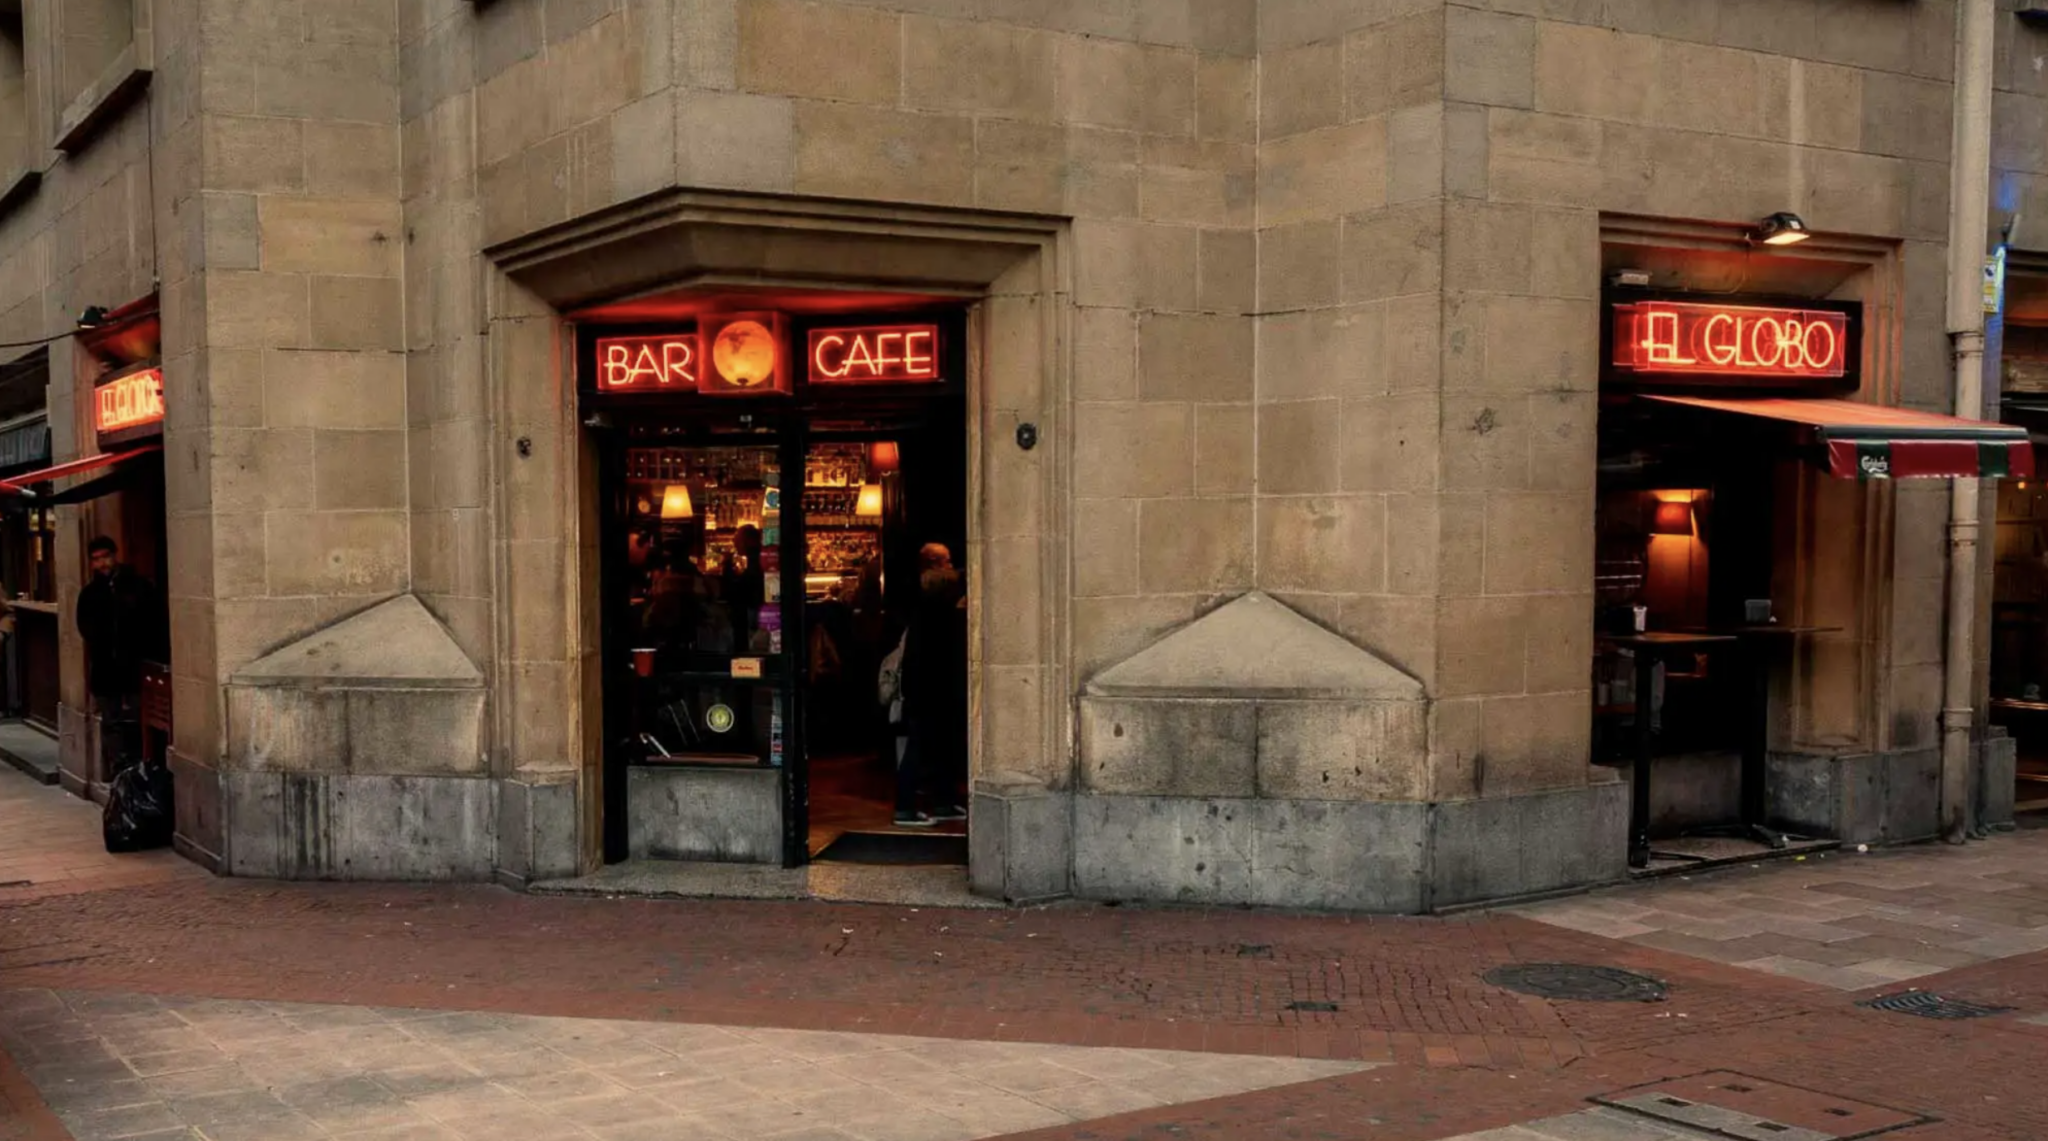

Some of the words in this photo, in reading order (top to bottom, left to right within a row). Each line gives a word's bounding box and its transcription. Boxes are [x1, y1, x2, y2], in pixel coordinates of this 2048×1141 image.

[815, 331, 931, 377] CAFE
[1641, 311, 1696, 364] EL
[1704, 313, 1835, 368] GLOBO
[603, 342, 695, 385] BAR
